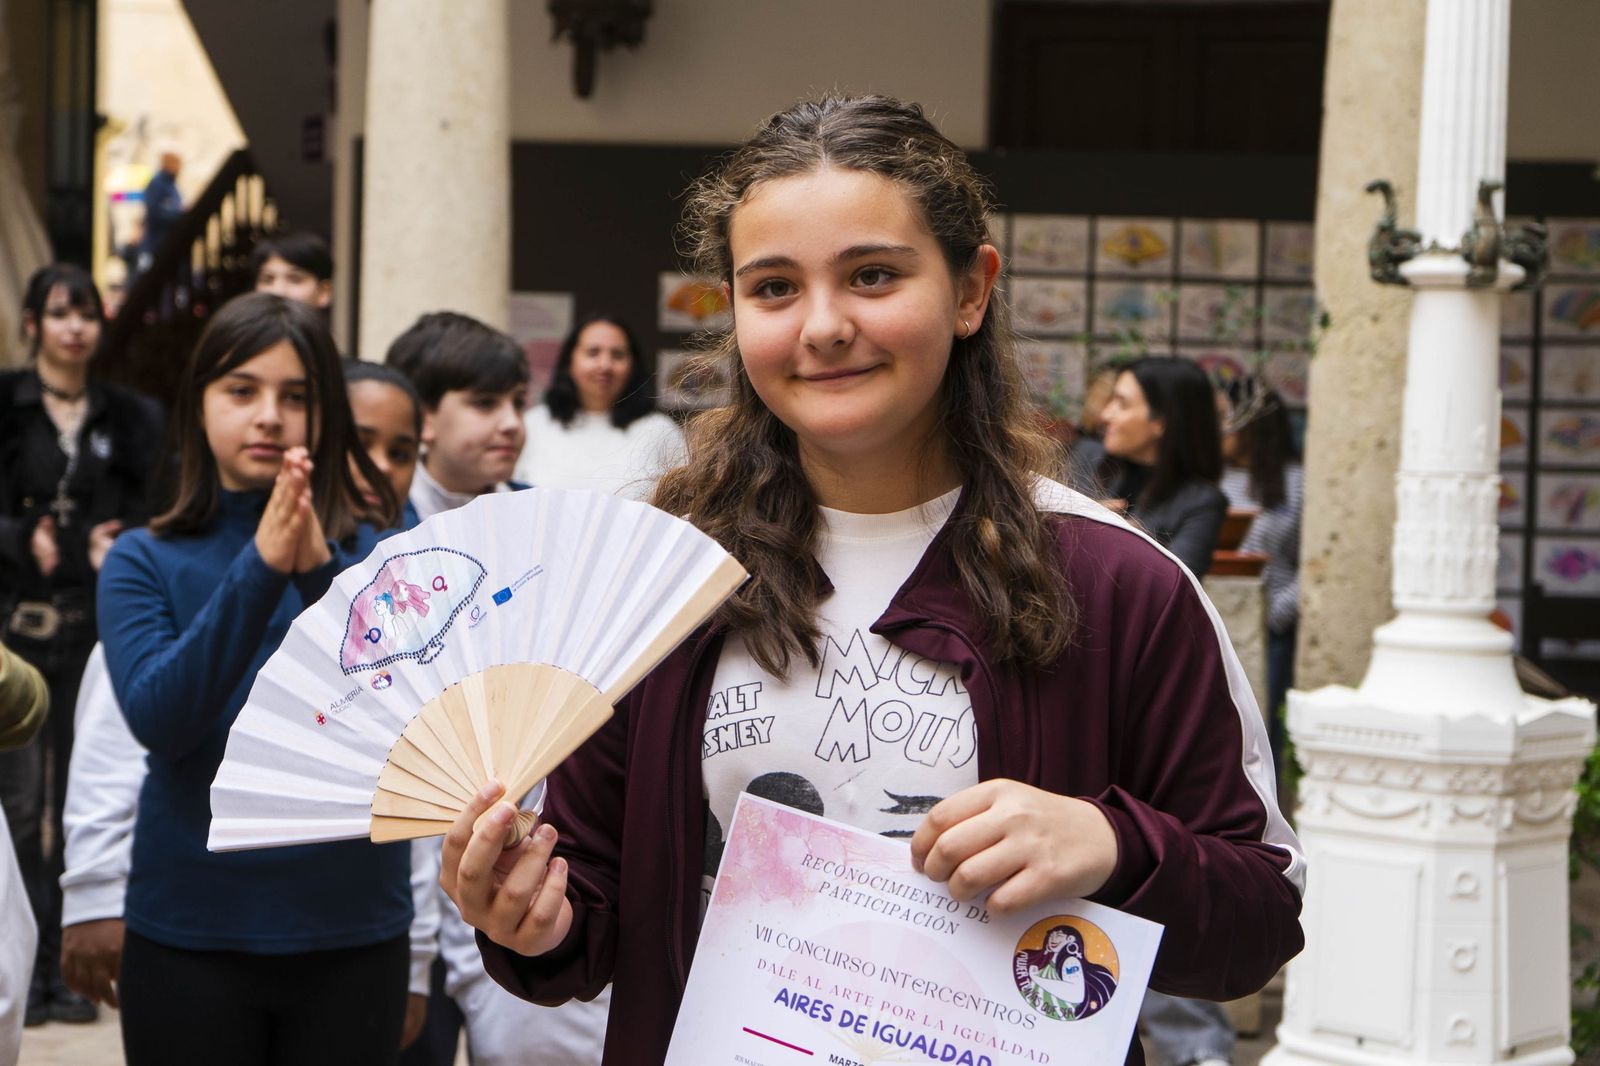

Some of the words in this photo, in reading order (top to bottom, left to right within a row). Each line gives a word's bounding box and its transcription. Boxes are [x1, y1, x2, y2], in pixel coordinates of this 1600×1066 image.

[704, 682, 762, 720] ALT
[701, 716, 775, 760] SNEY
[801, 853, 960, 914] RECONOCIMIENTO
[966, 905, 990, 924] DE
[818, 880, 961, 935] PARTICIPACIÓN
[755, 924, 772, 944] VII
[776, 932, 876, 978] CONCURSO
[881, 966, 1037, 1030] INTERCENTROS
[757, 958, 797, 982] DALE
[803, 974, 823, 991] AL
[832, 984, 874, 1008] ARTE
[880, 1000, 916, 1022] POR
[923, 1013, 944, 1030] LA
[953, 1024, 1050, 1065] IGUALDAD
[774, 987, 834, 1023] AIRES
[838, 1009, 868, 1034] DE
[872, 1021, 992, 1066] IGUALDAD
